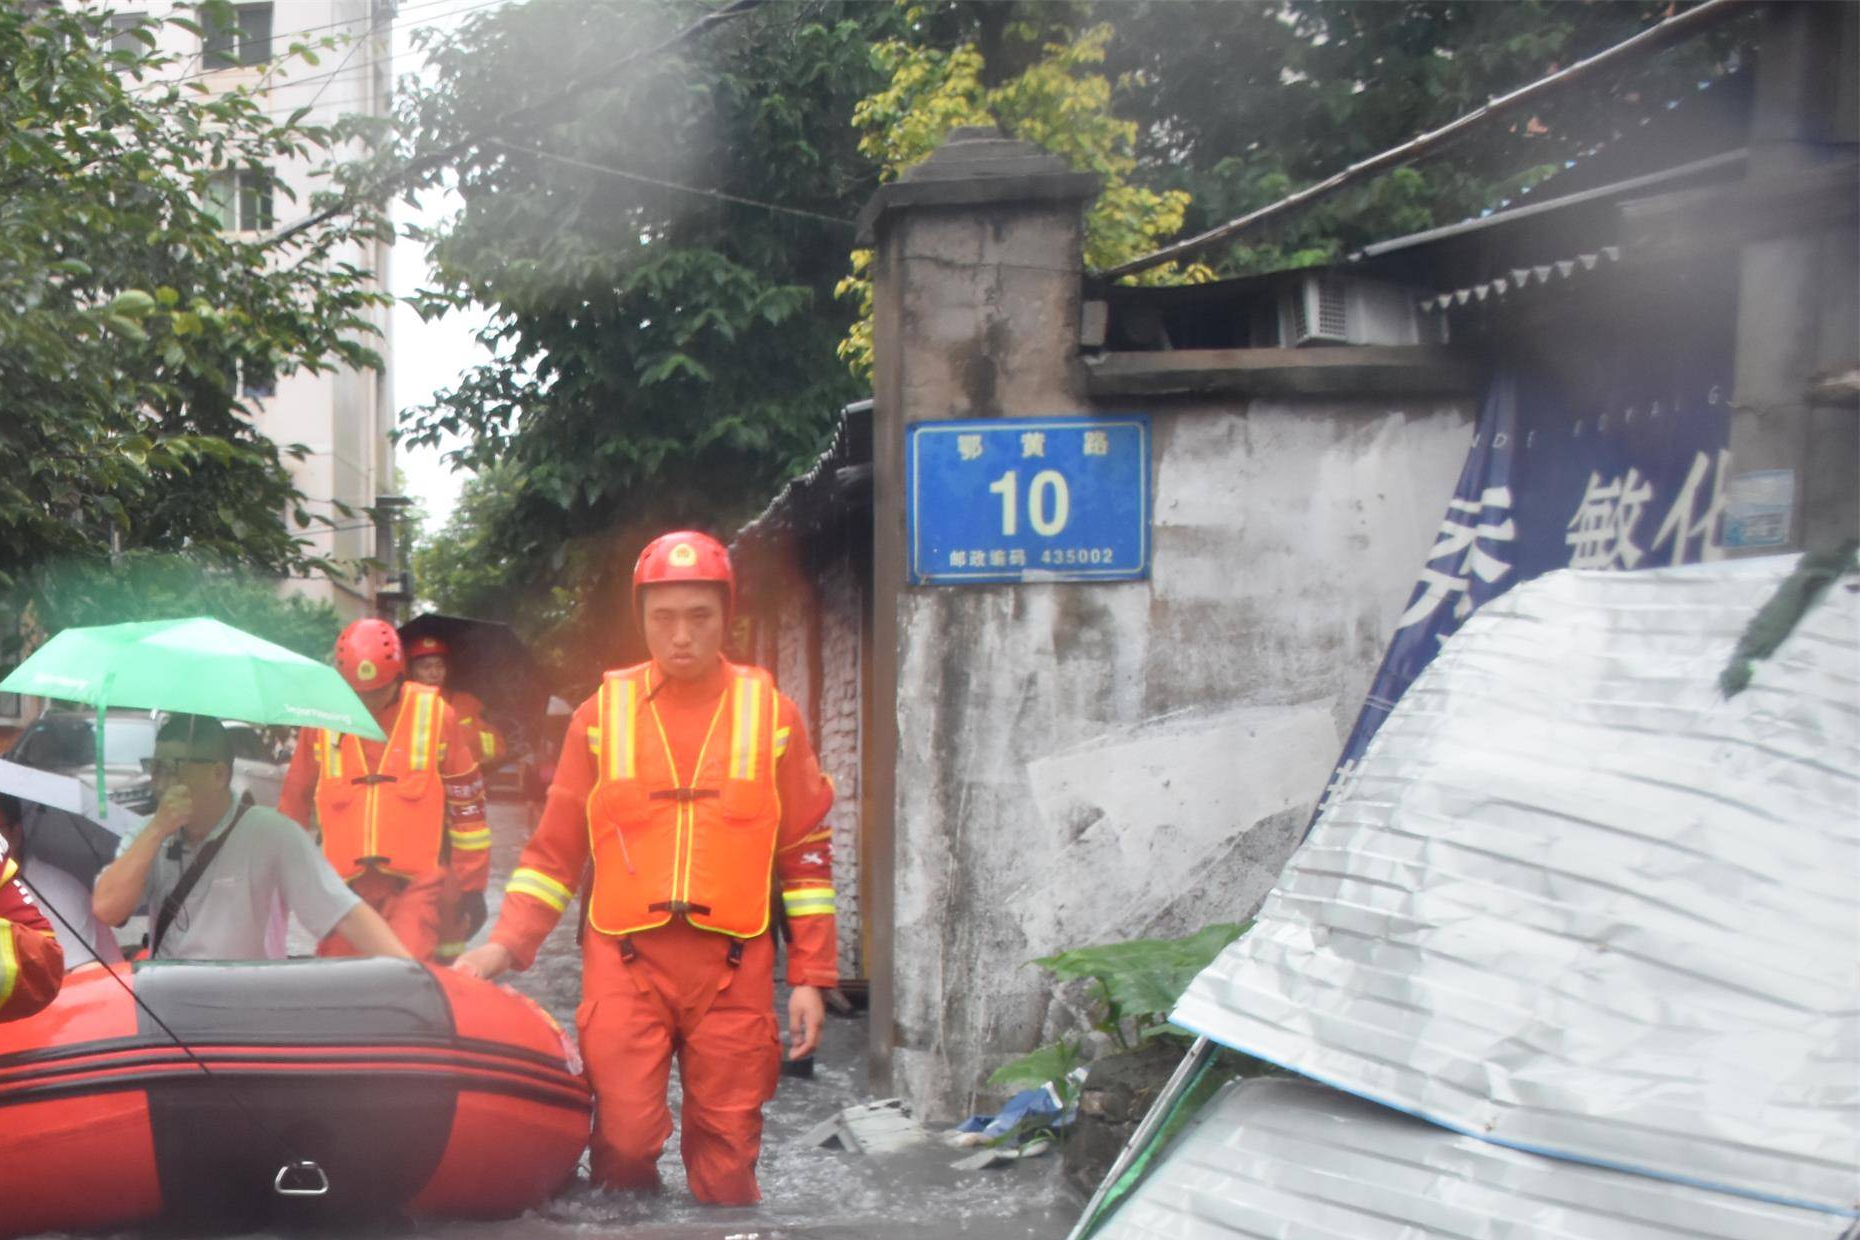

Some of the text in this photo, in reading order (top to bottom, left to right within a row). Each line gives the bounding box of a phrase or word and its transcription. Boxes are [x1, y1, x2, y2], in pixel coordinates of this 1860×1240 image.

[956, 431, 1109, 460] 鄂黄路
[989, 469, 1070, 537] 10
[949, 548, 1113, 567] 邮政编码 435002
